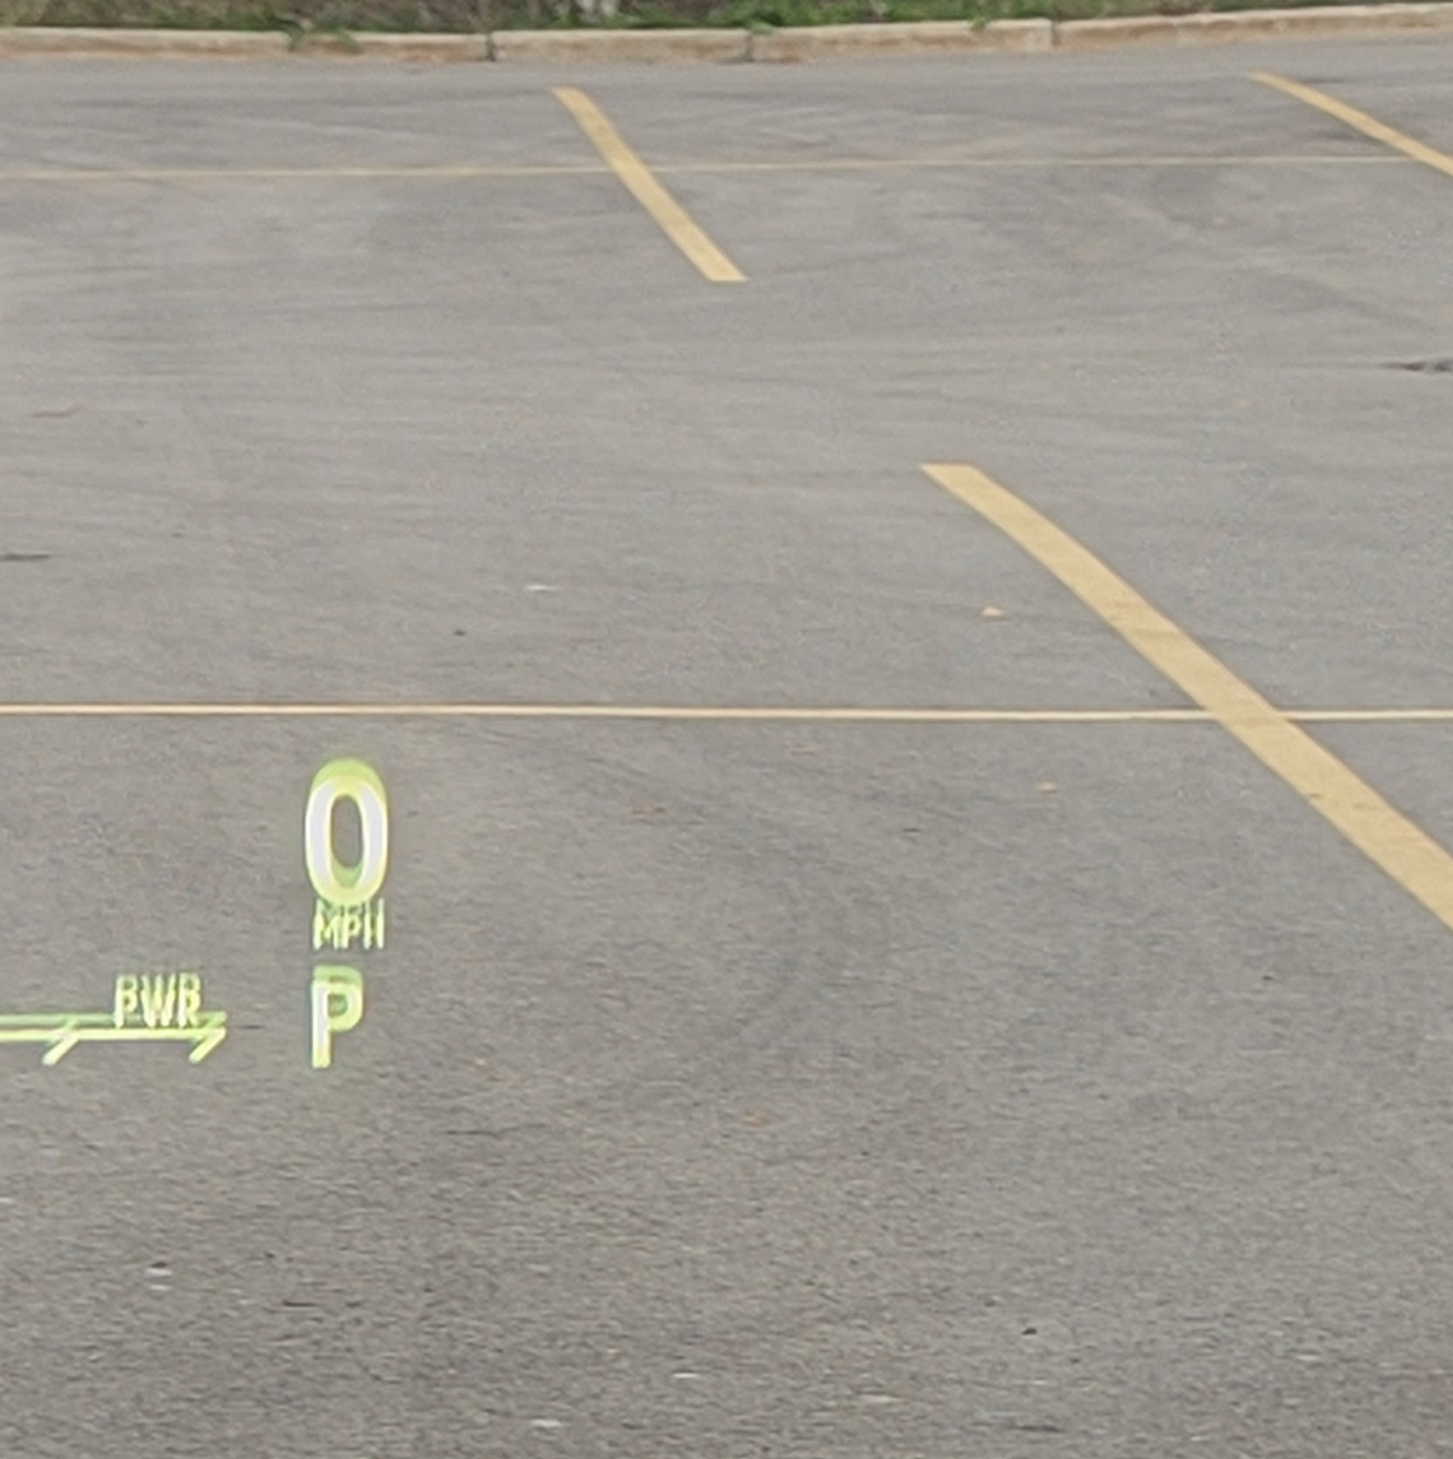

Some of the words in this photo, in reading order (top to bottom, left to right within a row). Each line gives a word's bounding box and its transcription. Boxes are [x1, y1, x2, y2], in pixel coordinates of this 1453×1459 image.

[302, 757, 390, 906] 0
[312, 898, 387, 950] MPH
[113, 972, 203, 1028] PWR
[309, 964, 367, 1069] P
